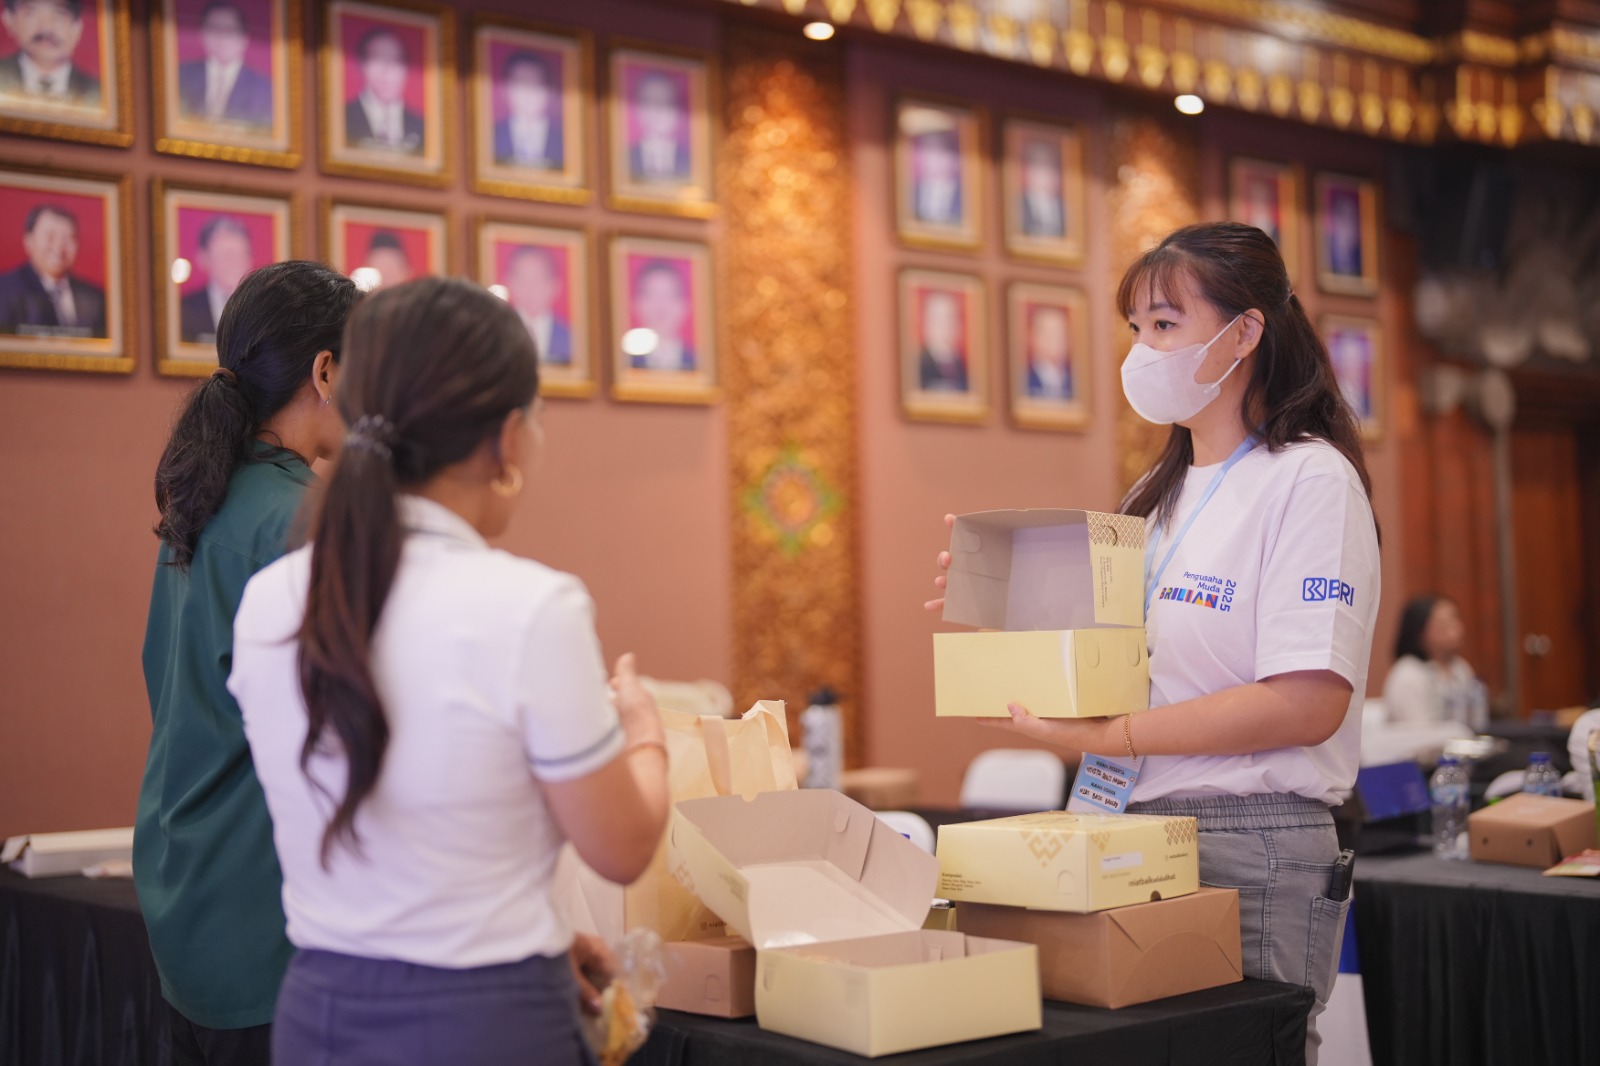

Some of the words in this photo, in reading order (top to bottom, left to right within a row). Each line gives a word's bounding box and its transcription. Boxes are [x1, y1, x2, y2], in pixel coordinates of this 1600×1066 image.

[1183, 571, 1223, 585] Pengusaha
[1197, 582, 1220, 593] Muda
[1159, 587, 1219, 609] BRILIAN
[1219, 579, 1237, 612] 2025
[1328, 579, 1354, 607] BRI
